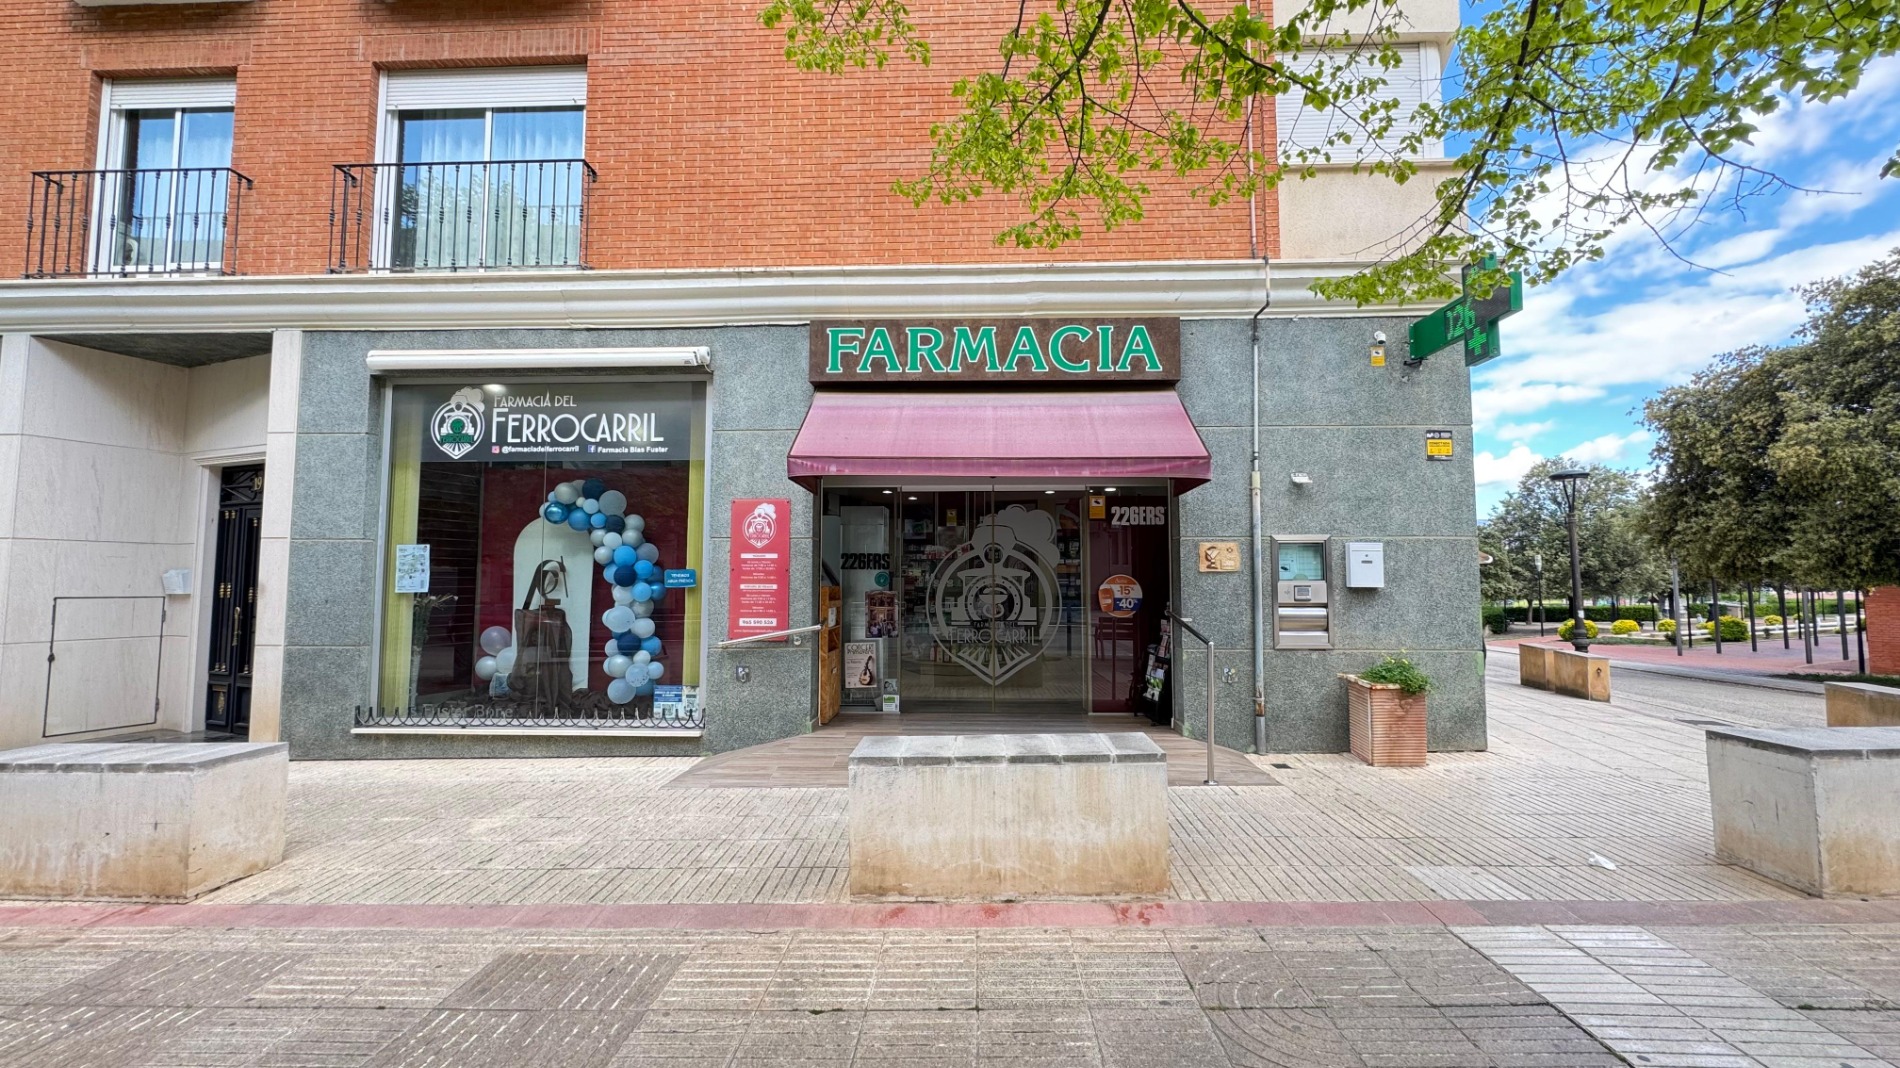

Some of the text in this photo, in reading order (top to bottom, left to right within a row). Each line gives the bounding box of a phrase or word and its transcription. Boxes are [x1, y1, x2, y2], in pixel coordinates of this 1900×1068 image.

[826, 325, 1162, 373] FARMACIA
[494, 390, 577, 408] FARMACIA DEL
[491, 408, 664, 443] FERROCARRIL
[597, 446, 627, 454] Farmacia
[254, 477, 262, 490] 19
[1110, 506, 1165, 526] 226ERS
[840, 552, 891, 570] 226ERS
